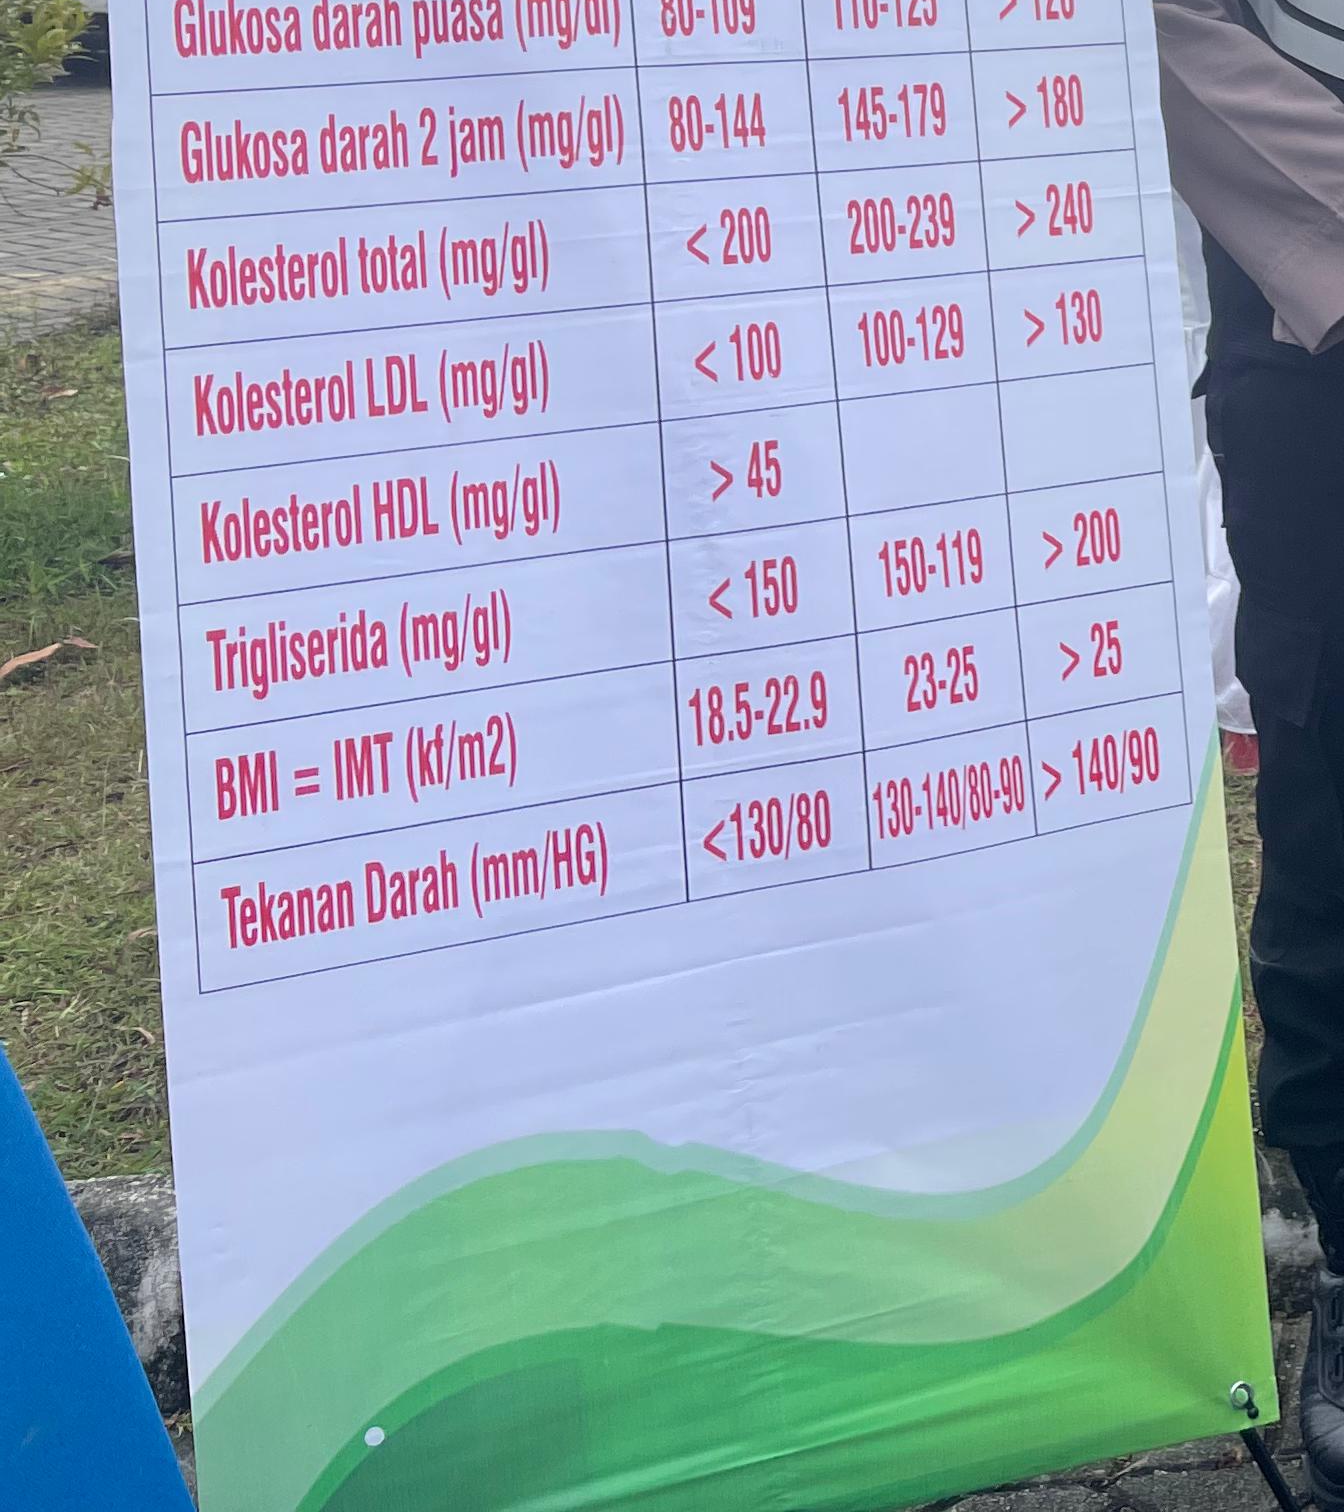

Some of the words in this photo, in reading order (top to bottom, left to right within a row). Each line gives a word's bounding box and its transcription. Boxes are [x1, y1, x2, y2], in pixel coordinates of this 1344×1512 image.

[669, 94, 766, 152] 80-144
[839, 83, 945, 140] 145-179
[1007, 94, 1026, 125] >
[1037, 75, 1083, 126] 180
[181, 120, 308, 184] Glukosa
[320, 112, 408, 173] darah
[420, 108, 438, 166] 2
[449, 107, 505, 177] jam
[517, 96, 624, 168] (mg/gl)
[688, 226, 708, 263] <
[721, 208, 771, 264] 200
[848, 193, 954, 254] 200-239
[1016, 201, 1034, 233] >
[1046, 183, 1092, 236] 240
[188, 238, 348, 308] Kolesterol
[359, 232, 427, 293] total
[440, 222, 548, 296] (mg/gl)
[859, 304, 964, 366] 100-129
[1025, 312, 1044, 344] >
[1056, 290, 1102, 344] 130
[694, 344, 717, 380] <
[730, 322, 781, 380] 100
[195, 361, 356, 436] Kolesterol
[366, 355, 427, 417] LDL
[440, 344, 548, 418] (mg/gl)
[711, 463, 733, 499] >
[748, 440, 781, 497] 45
[202, 485, 362, 563] Kolesterol
[372, 477, 439, 541] HDL
[451, 463, 560, 542] (mg/gl)
[1043, 533, 1063, 567] >
[1074, 508, 1120, 567] 200
[709, 580, 732, 617] <
[745, 556, 798, 616] 150
[879, 529, 983, 596] 150-119
[206, 610, 387, 700] Trigliserida
[400, 592, 511, 676] (mg/gl)
[1060, 644, 1081, 678] >
[1091, 620, 1122, 677] 25
[688, 671, 827, 744] 18.5-22.9
[905, 645, 978, 712] 23-25
[216, 751, 278, 820] BMI
[294, 768, 320, 796] =
[334, 732, 393, 801] IMT
[406, 713, 516, 801] (kf/m2)
[1043, 763, 1061, 797] >
[1072, 728, 1160, 793] 140/90
[704, 791, 831, 860] <130/80
[873, 756, 1024, 838] 130-140/80-90
[221, 881, 355, 948] Tekanan
[365, 851, 459, 923] Darah
[471, 823, 608, 915] (mm/HG)
